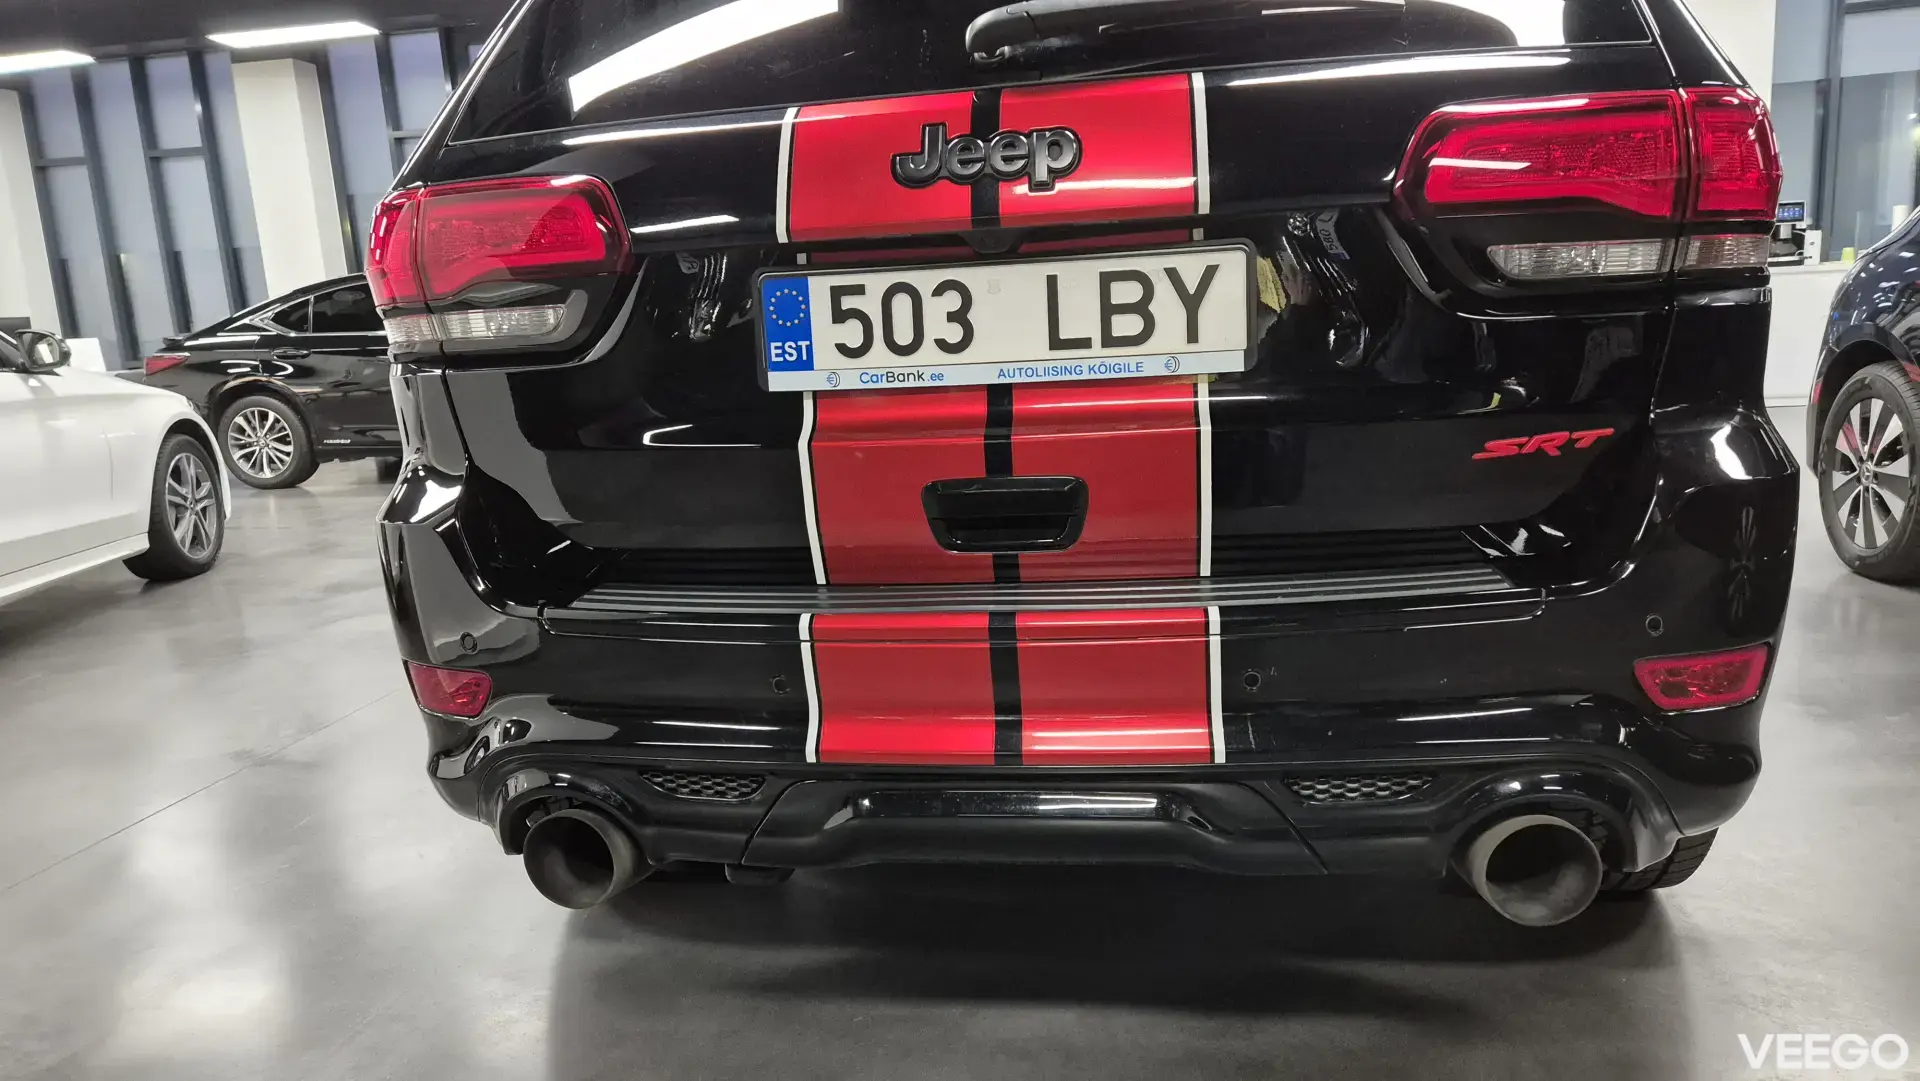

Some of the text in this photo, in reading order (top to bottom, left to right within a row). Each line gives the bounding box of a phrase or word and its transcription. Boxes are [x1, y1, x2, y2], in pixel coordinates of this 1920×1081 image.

[892, 123, 1082, 191] Jeep
[829, 263, 1220, 359] 503 LBY
[770, 341, 810, 362] EST
[997, 360, 1144, 380] AUTOLIISING KÕIGILE
[1471, 427, 1615, 460] SRT
